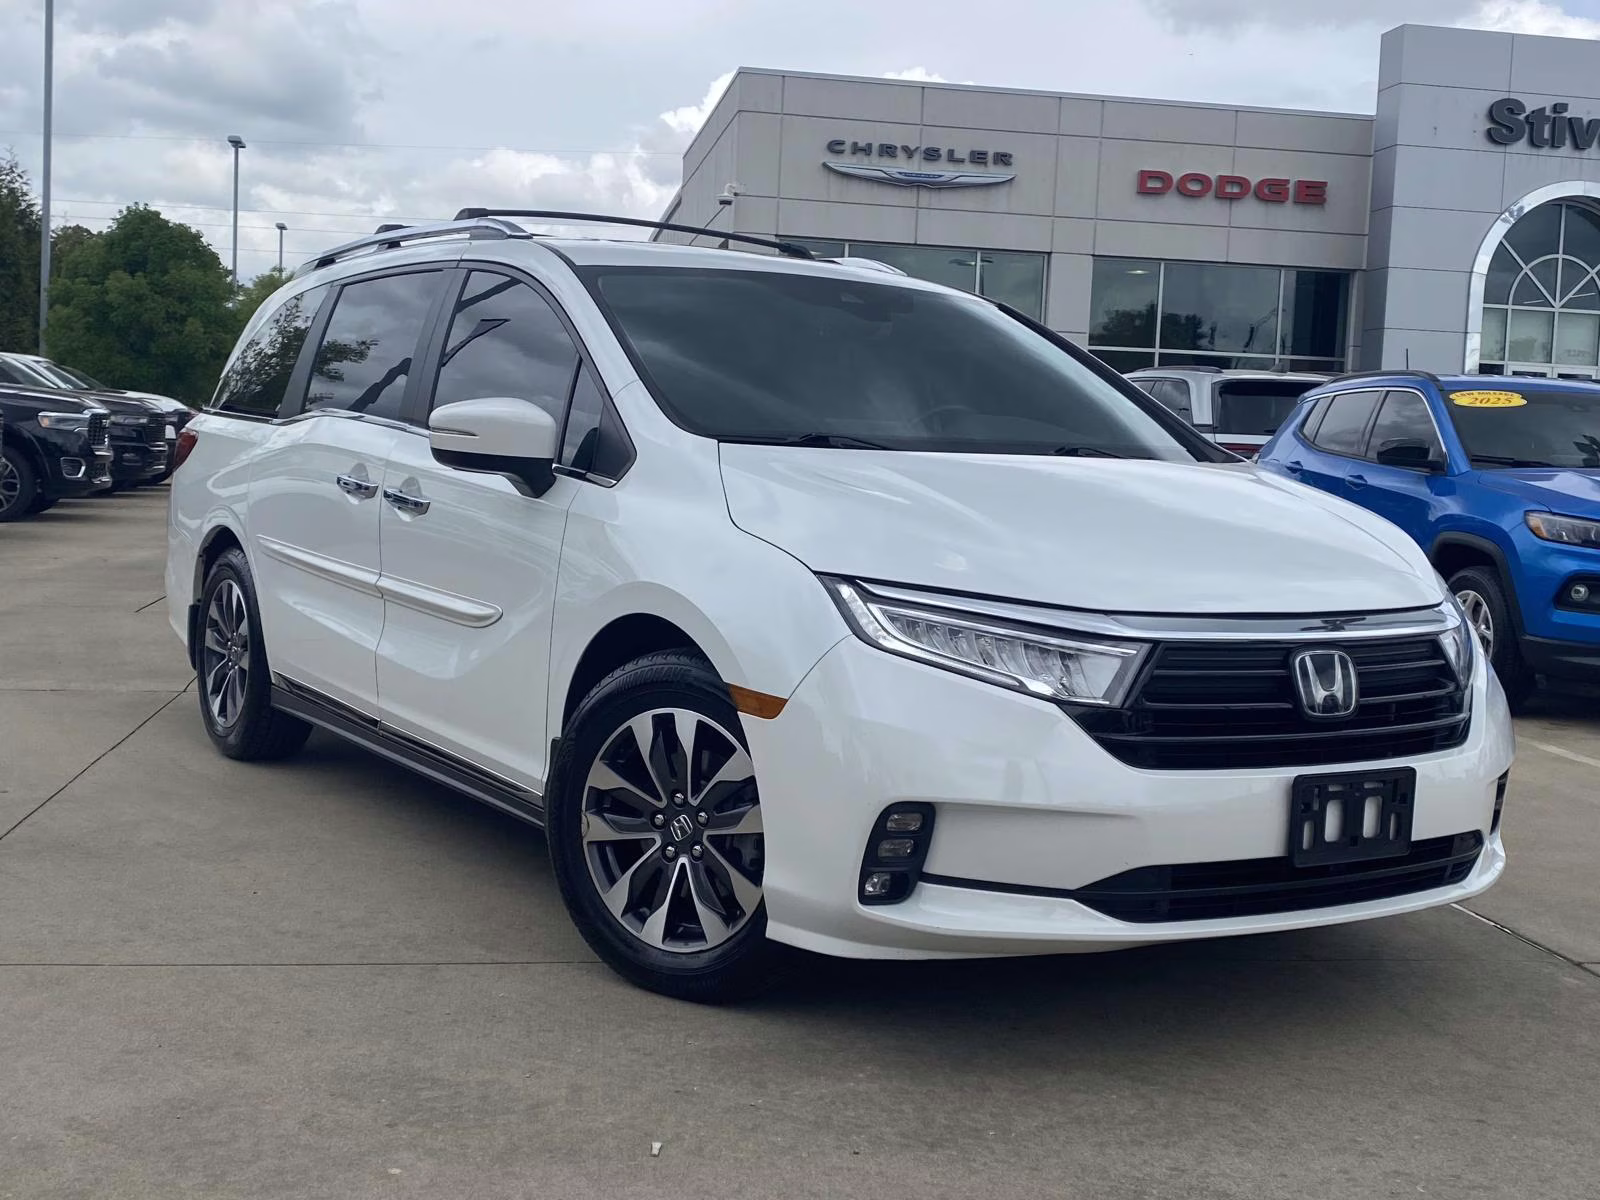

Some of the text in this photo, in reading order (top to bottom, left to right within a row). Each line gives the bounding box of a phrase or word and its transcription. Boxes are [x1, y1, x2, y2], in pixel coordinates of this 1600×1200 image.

[1486, 97, 1600, 150] Stiv
[826, 139, 1014, 167] CHRYSLER
[1137, 169, 1328, 205] DODGE
[1467, 397, 1513, 405] 2025
